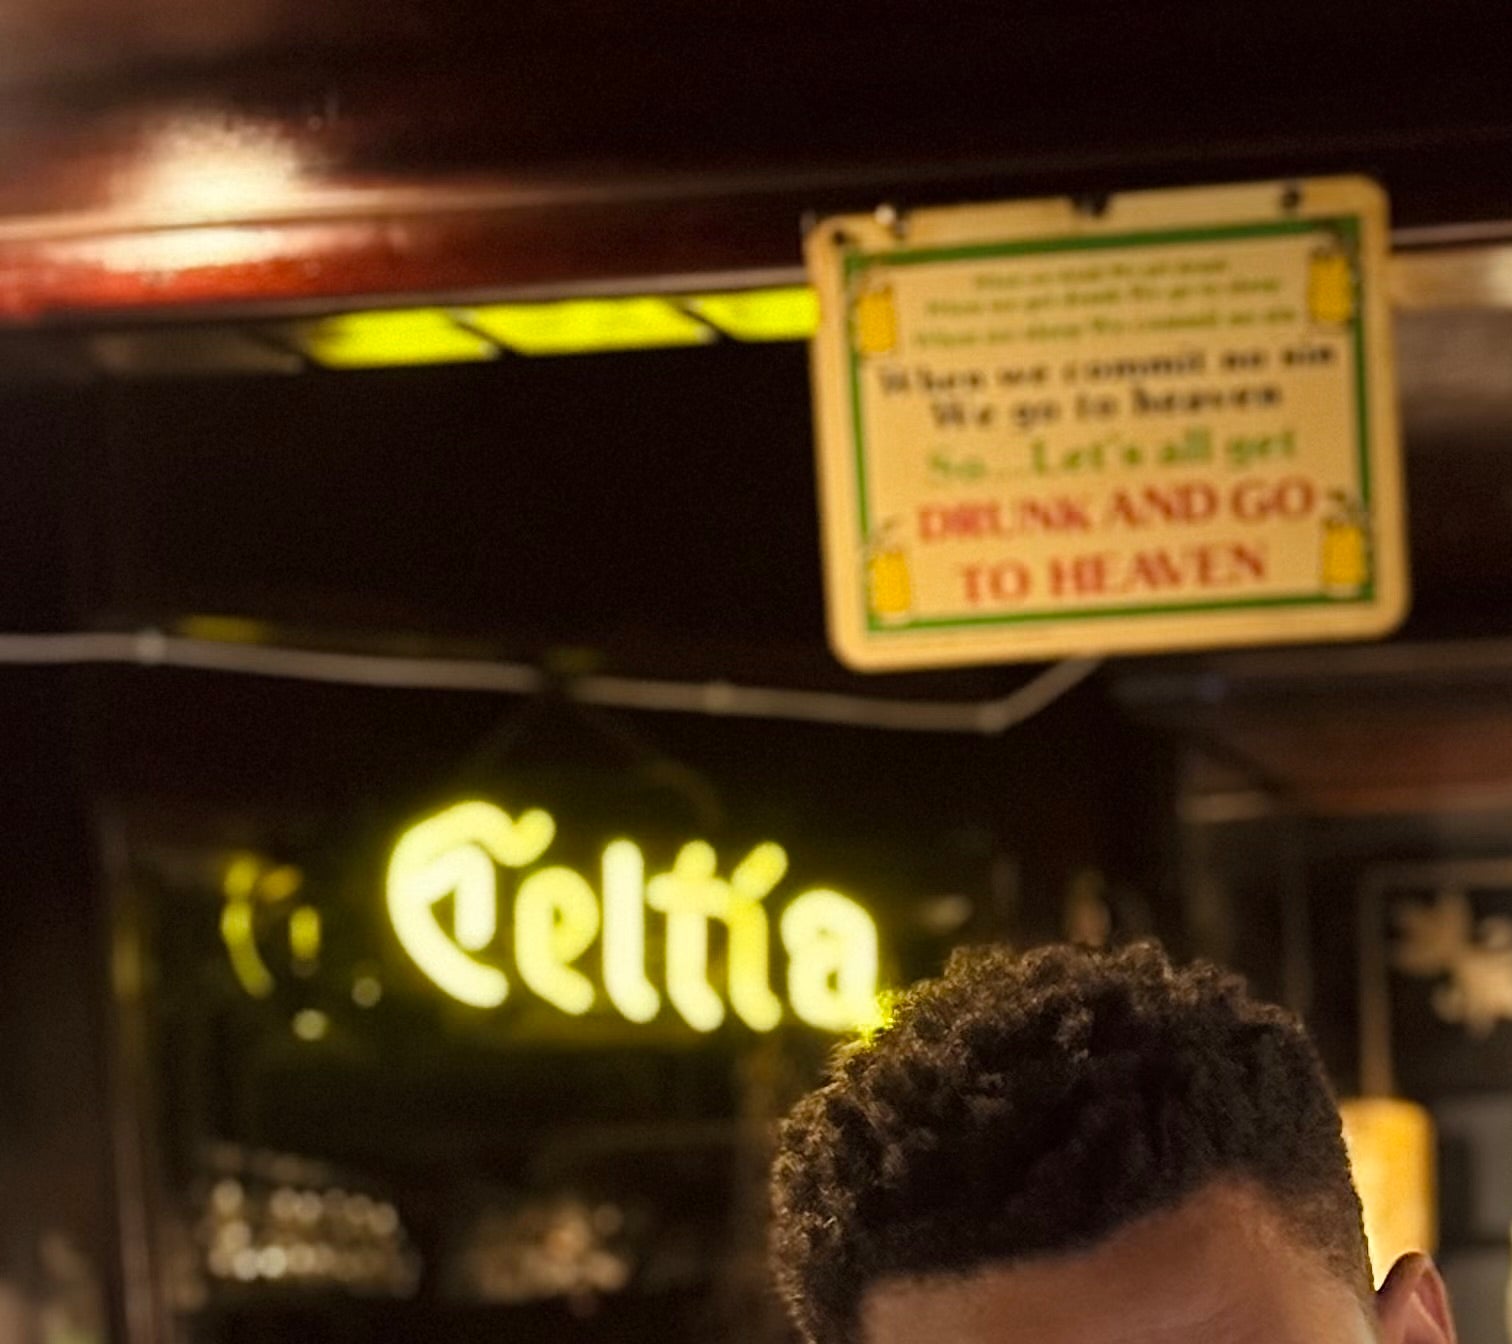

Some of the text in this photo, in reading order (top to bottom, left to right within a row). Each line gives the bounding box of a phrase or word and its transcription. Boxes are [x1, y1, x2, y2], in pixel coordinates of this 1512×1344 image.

[931, 385, 1283, 430] We go to heaven
[1156, 426, 1213, 466] all
[1224, 429, 1297, 472] get
[917, 474, 1314, 543] DRUNK AND GO
[960, 542, 1266, 604] TO HEAVEN
